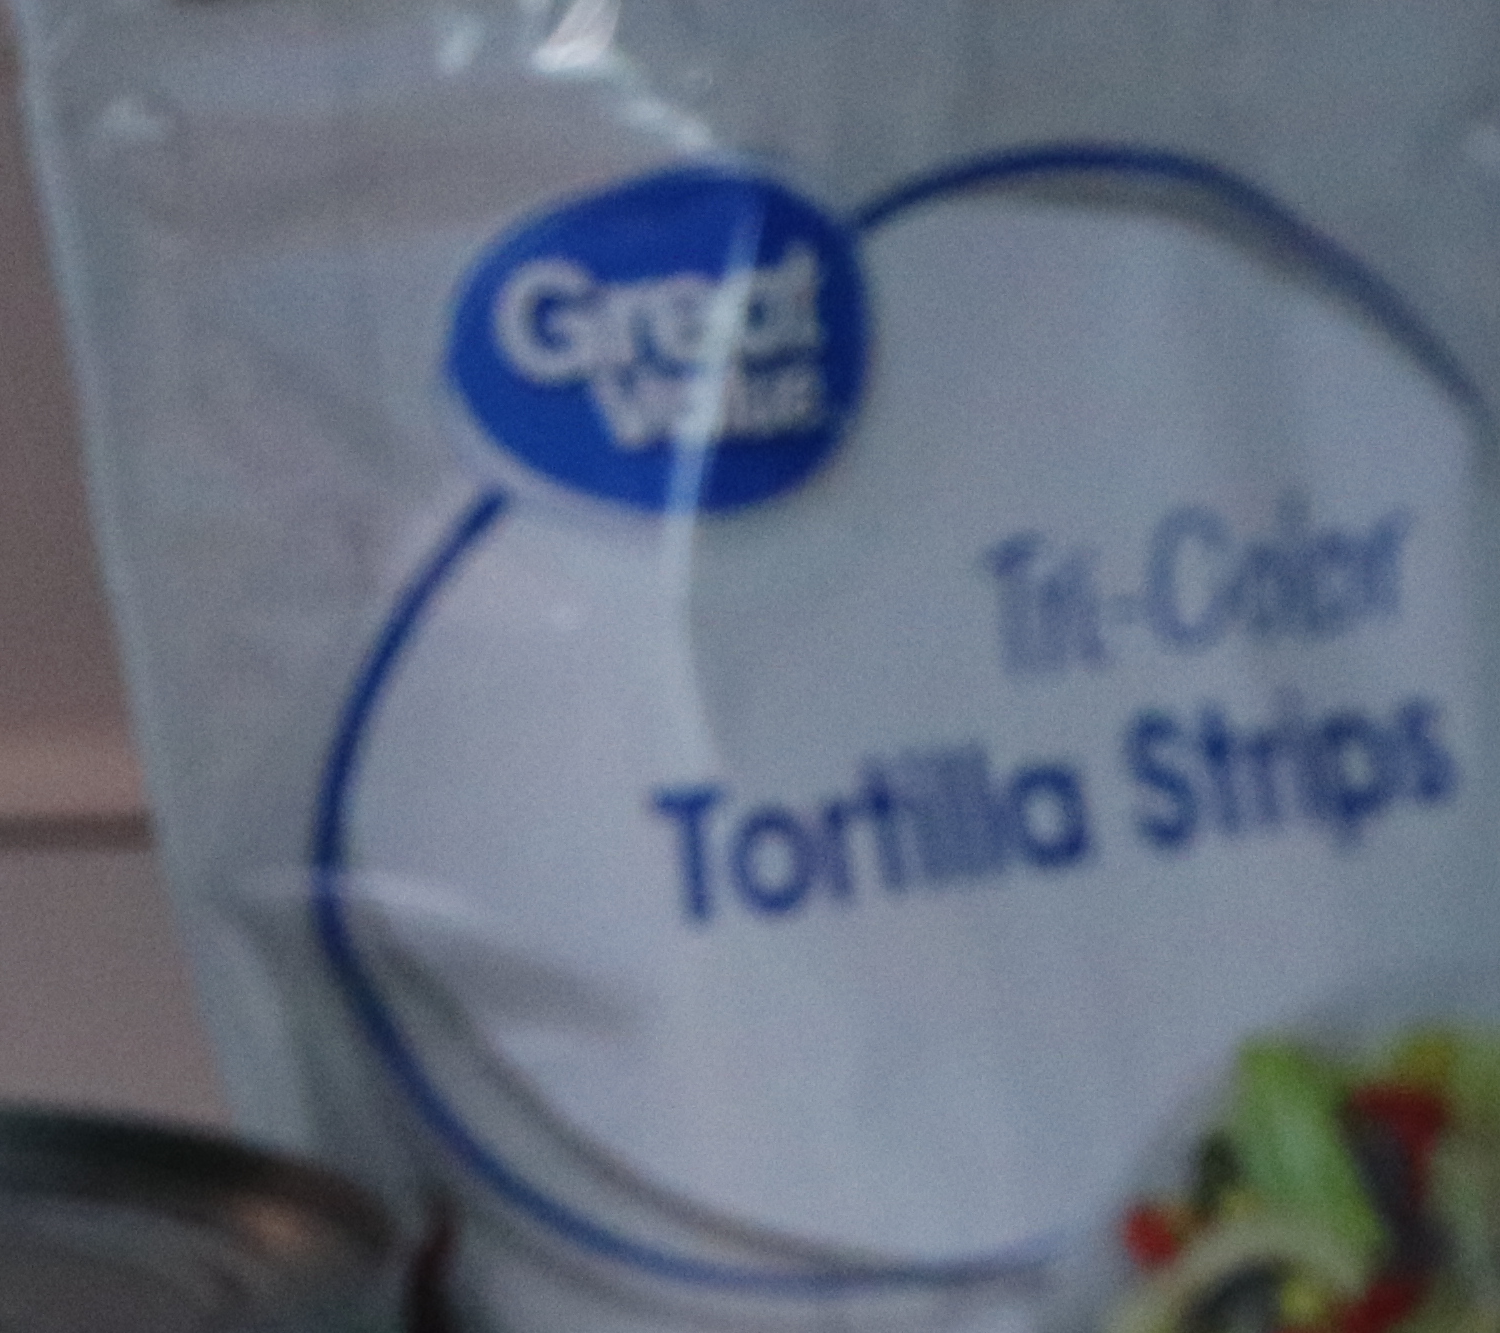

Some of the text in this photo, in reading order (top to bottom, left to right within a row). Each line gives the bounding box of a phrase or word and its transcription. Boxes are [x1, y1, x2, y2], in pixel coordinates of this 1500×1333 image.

[494, 244, 820, 384] Great
[983, 492, 1412, 676] Tri-Color
[649, 686, 1455, 923] Tortilla Strips
